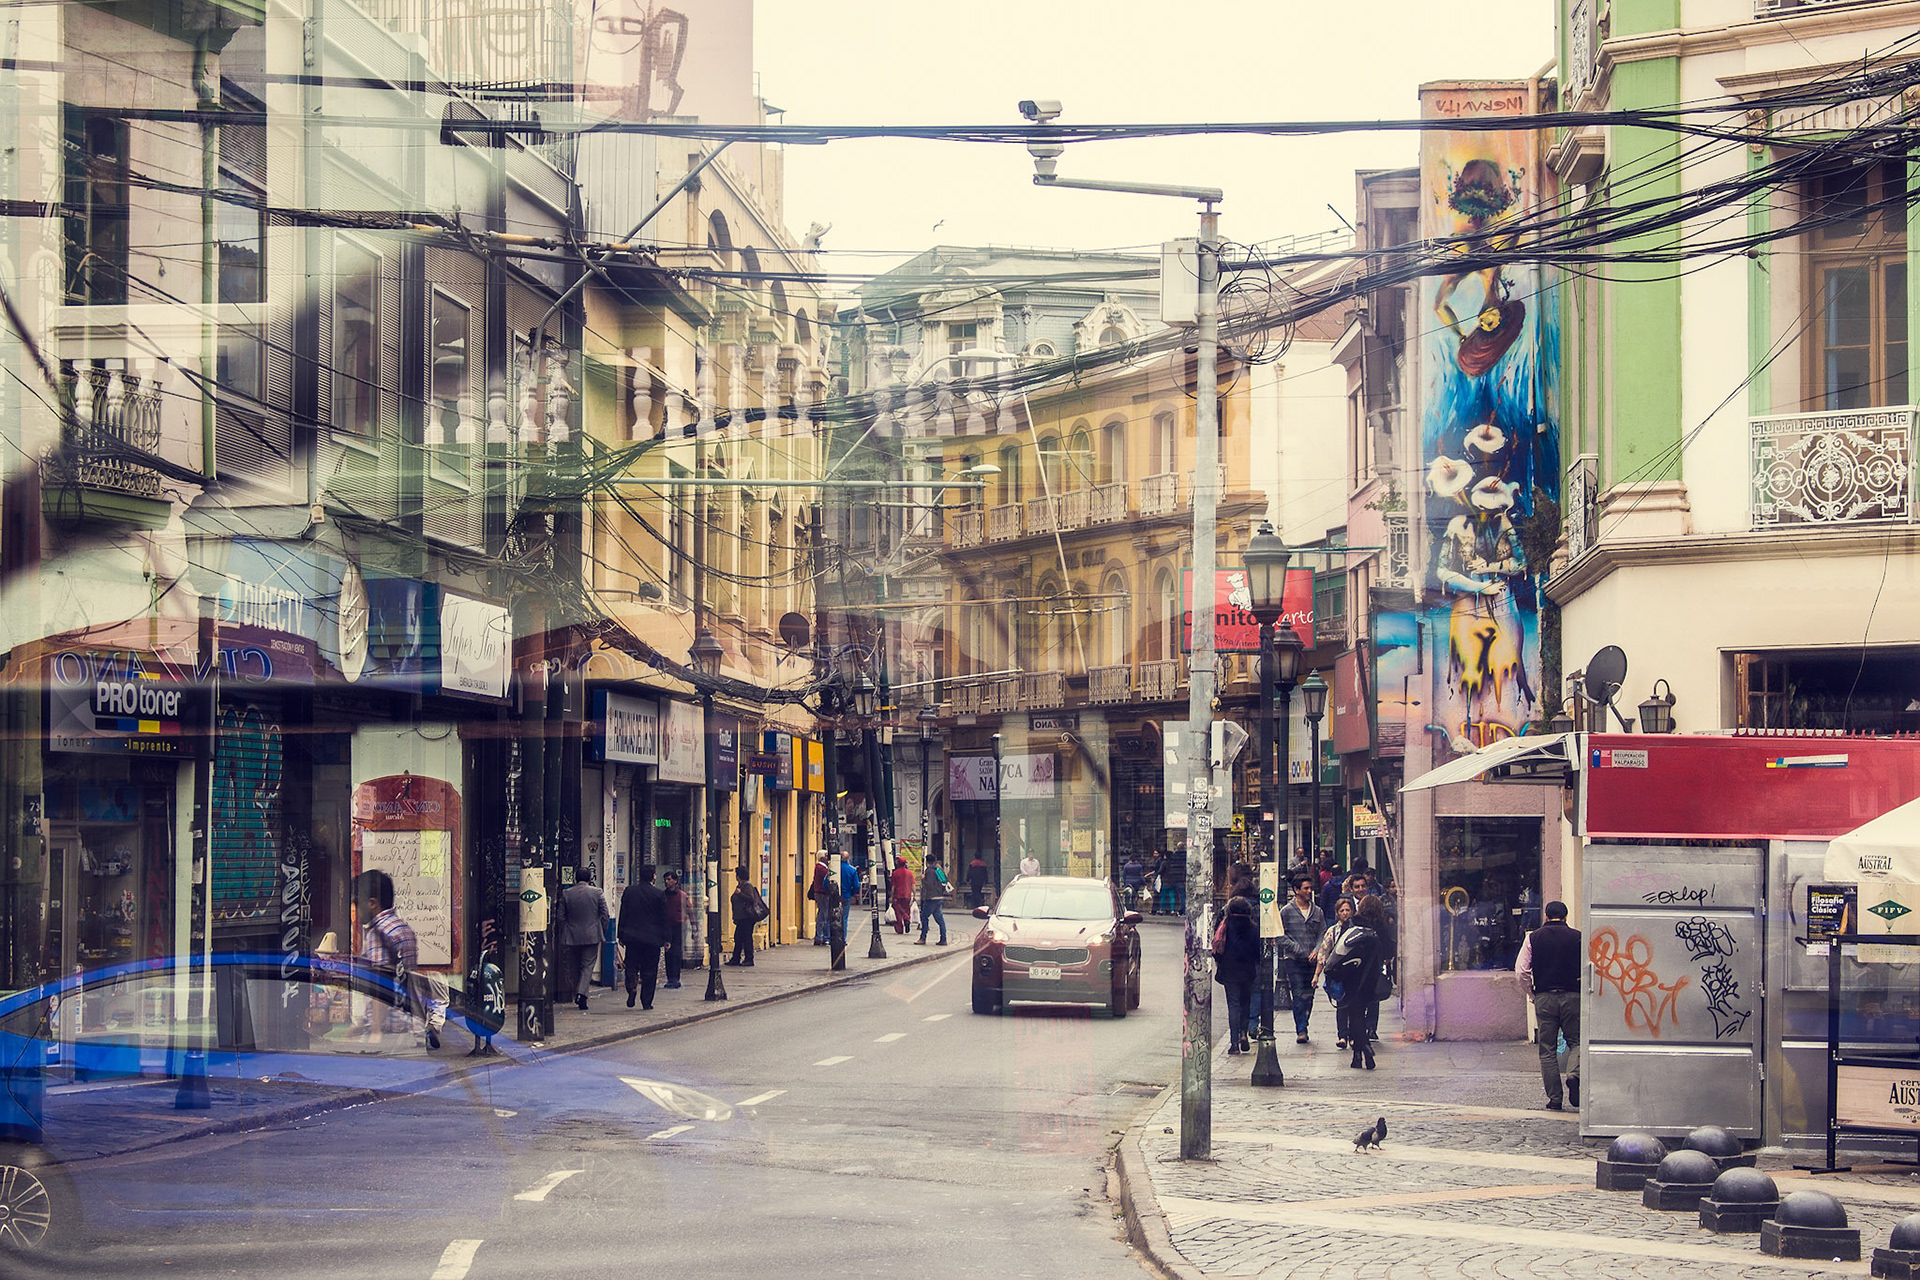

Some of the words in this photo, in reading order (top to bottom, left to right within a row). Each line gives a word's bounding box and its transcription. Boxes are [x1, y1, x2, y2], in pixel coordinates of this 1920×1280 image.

[243, 582, 305, 635] DIRECTV
[57, 735, 85, 748] Toner
[128, 738, 172, 753] Imprenta
[751, 761, 776, 770] SUSHI
[1858, 856, 1892, 870] AUSTRAL
